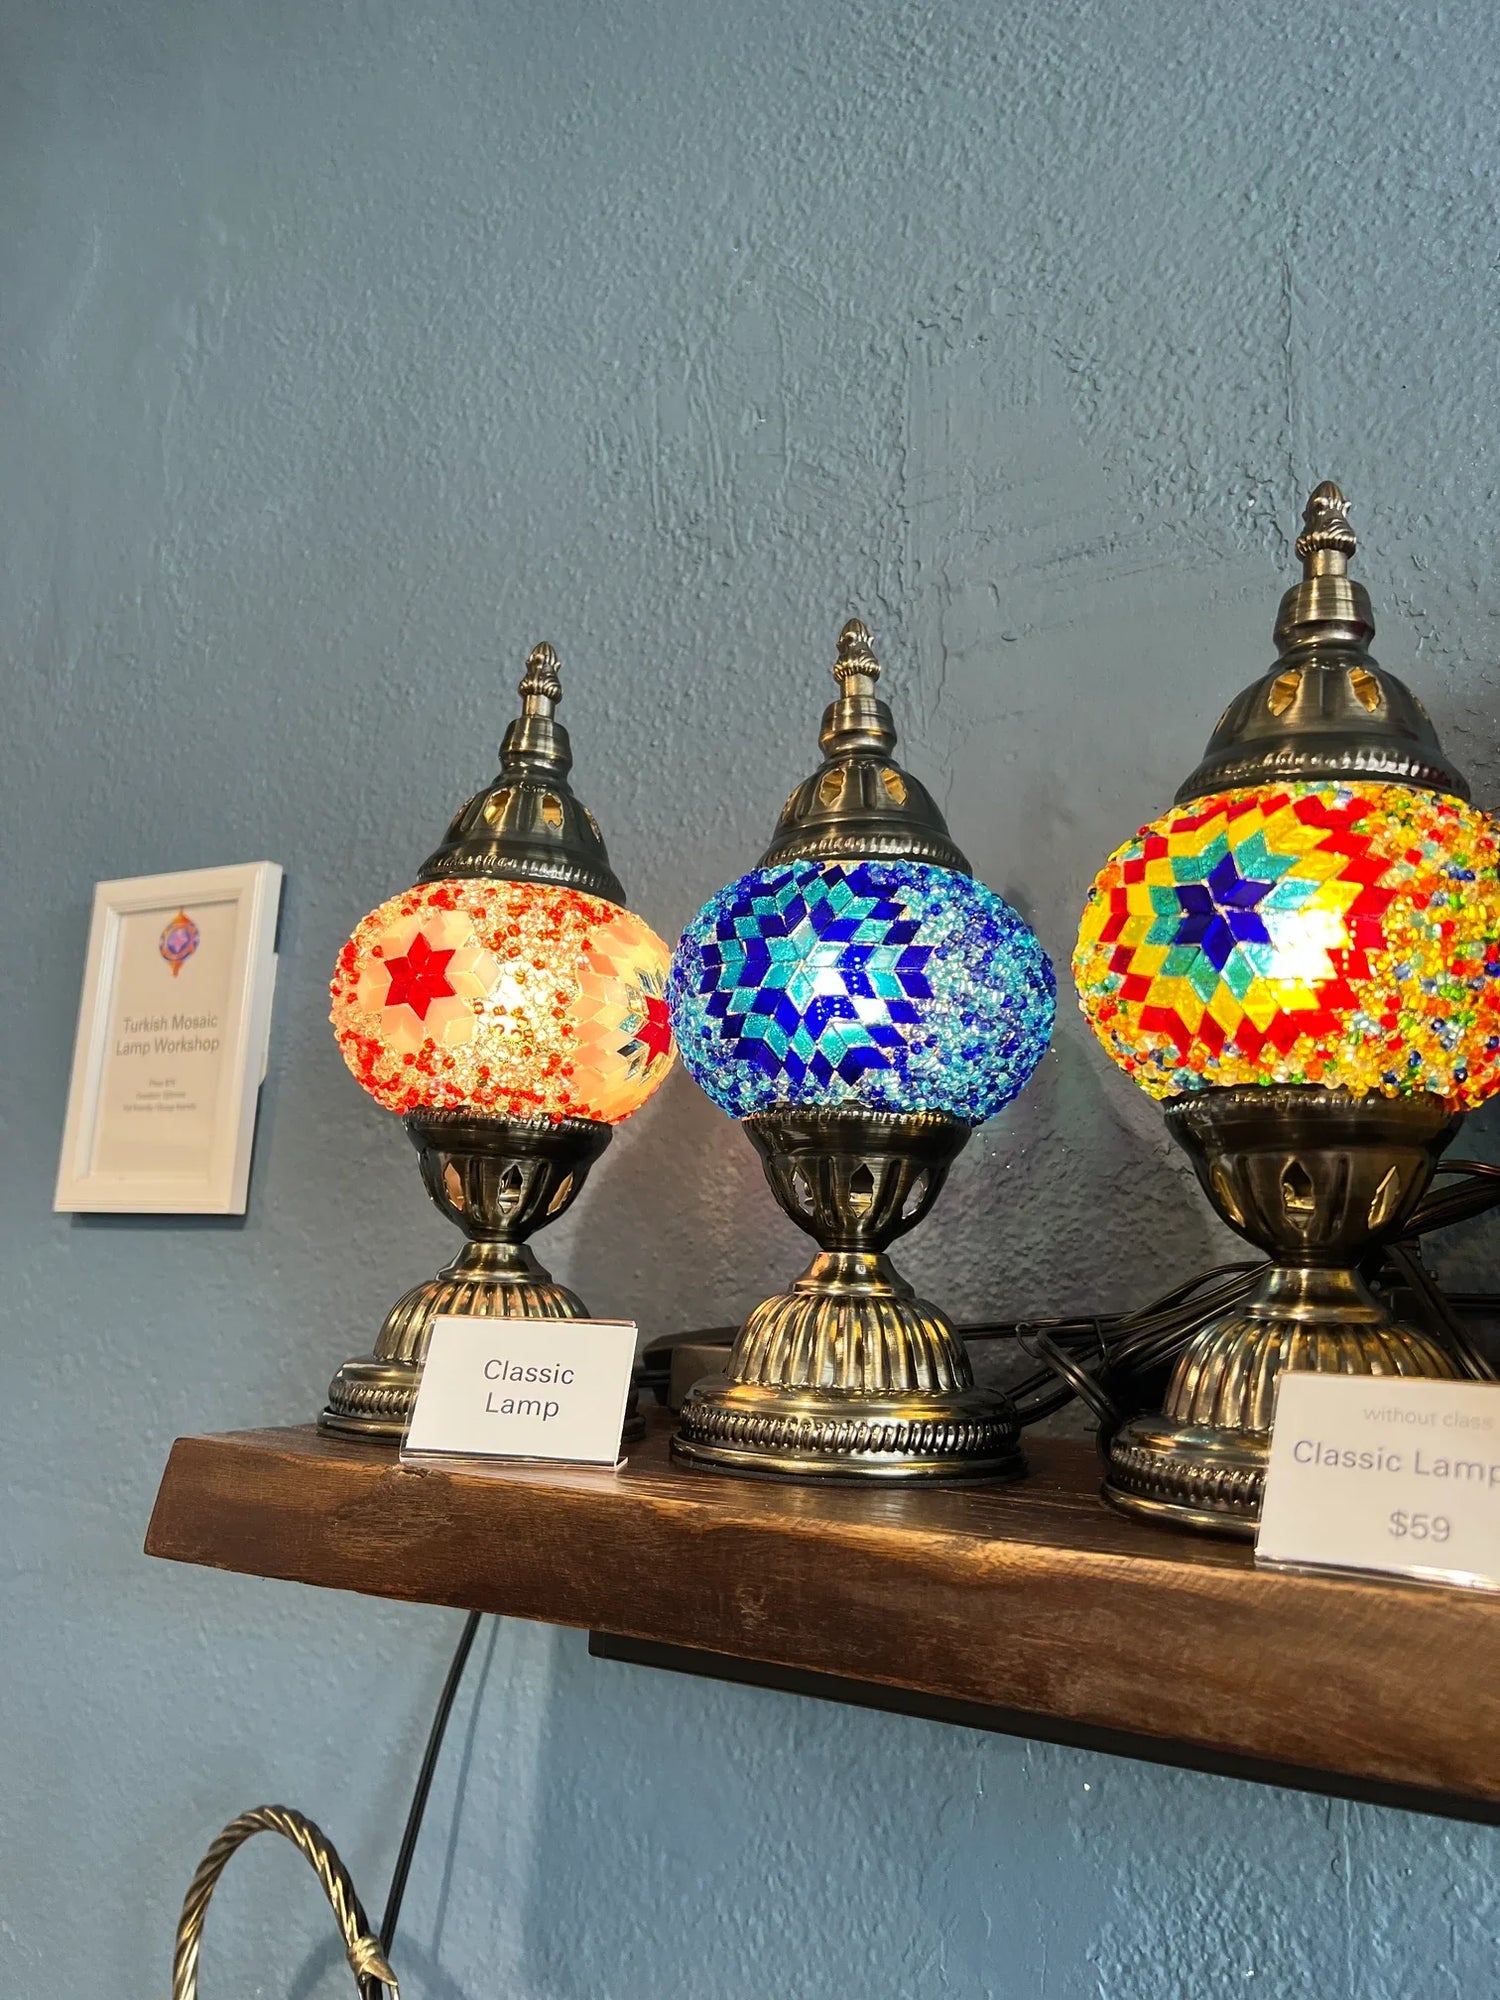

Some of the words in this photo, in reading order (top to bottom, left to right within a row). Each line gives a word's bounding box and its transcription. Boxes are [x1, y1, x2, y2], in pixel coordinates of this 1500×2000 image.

[123, 1015, 168, 1033] Turkish
[171, 1010, 218, 1031] Mosaic
[116, 1039, 151, 1057] Lamp
[154, 1035, 220, 1055] Workshop
[483, 1358, 575, 1385] Classic
[485, 1391, 560, 1422] Lamp
[1363, 1406, 1437, 1428] without
[1293, 1439, 1401, 1472] Classic
[1414, 1450, 1500, 1488] Lamp
[1387, 1508, 1452, 1544] $59
